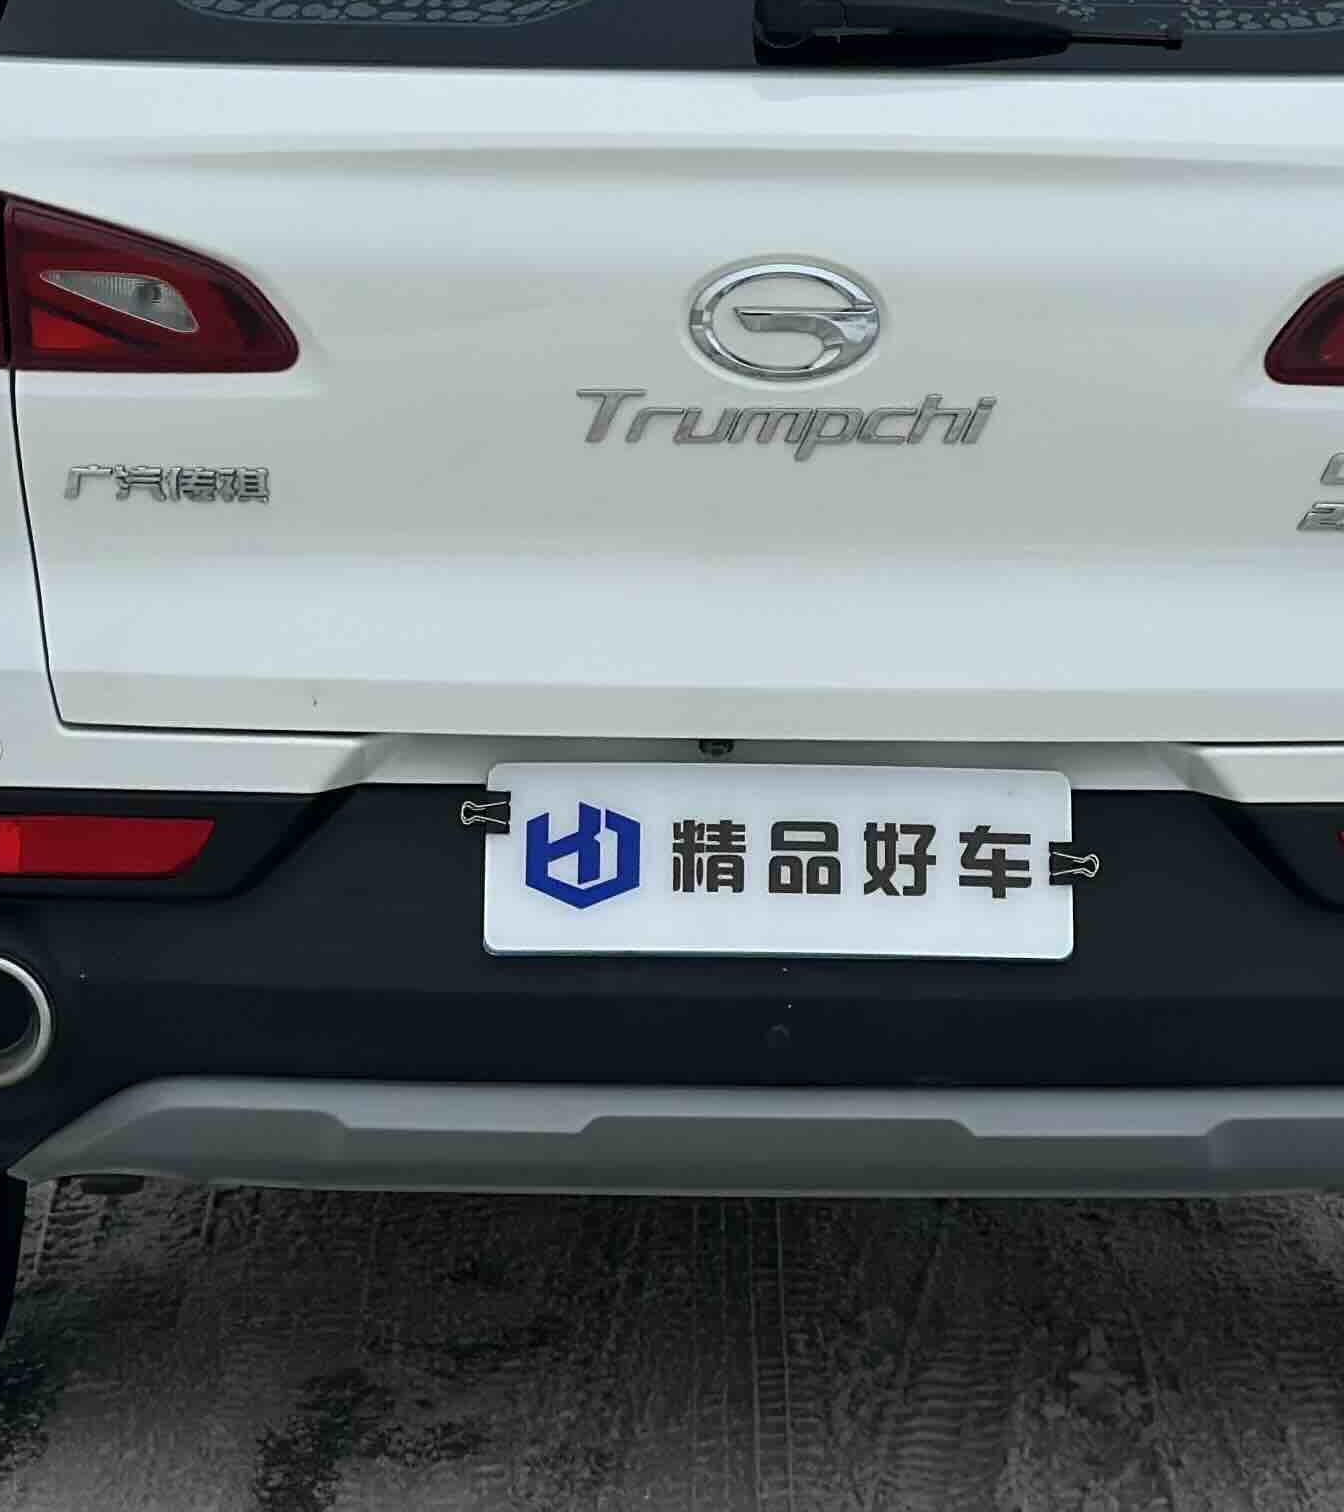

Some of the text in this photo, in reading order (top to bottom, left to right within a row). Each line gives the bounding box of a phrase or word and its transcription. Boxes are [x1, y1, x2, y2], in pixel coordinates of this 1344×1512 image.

[575, 388, 998, 462] Trumpchi
[671, 819, 1033, 899] 精品好车
